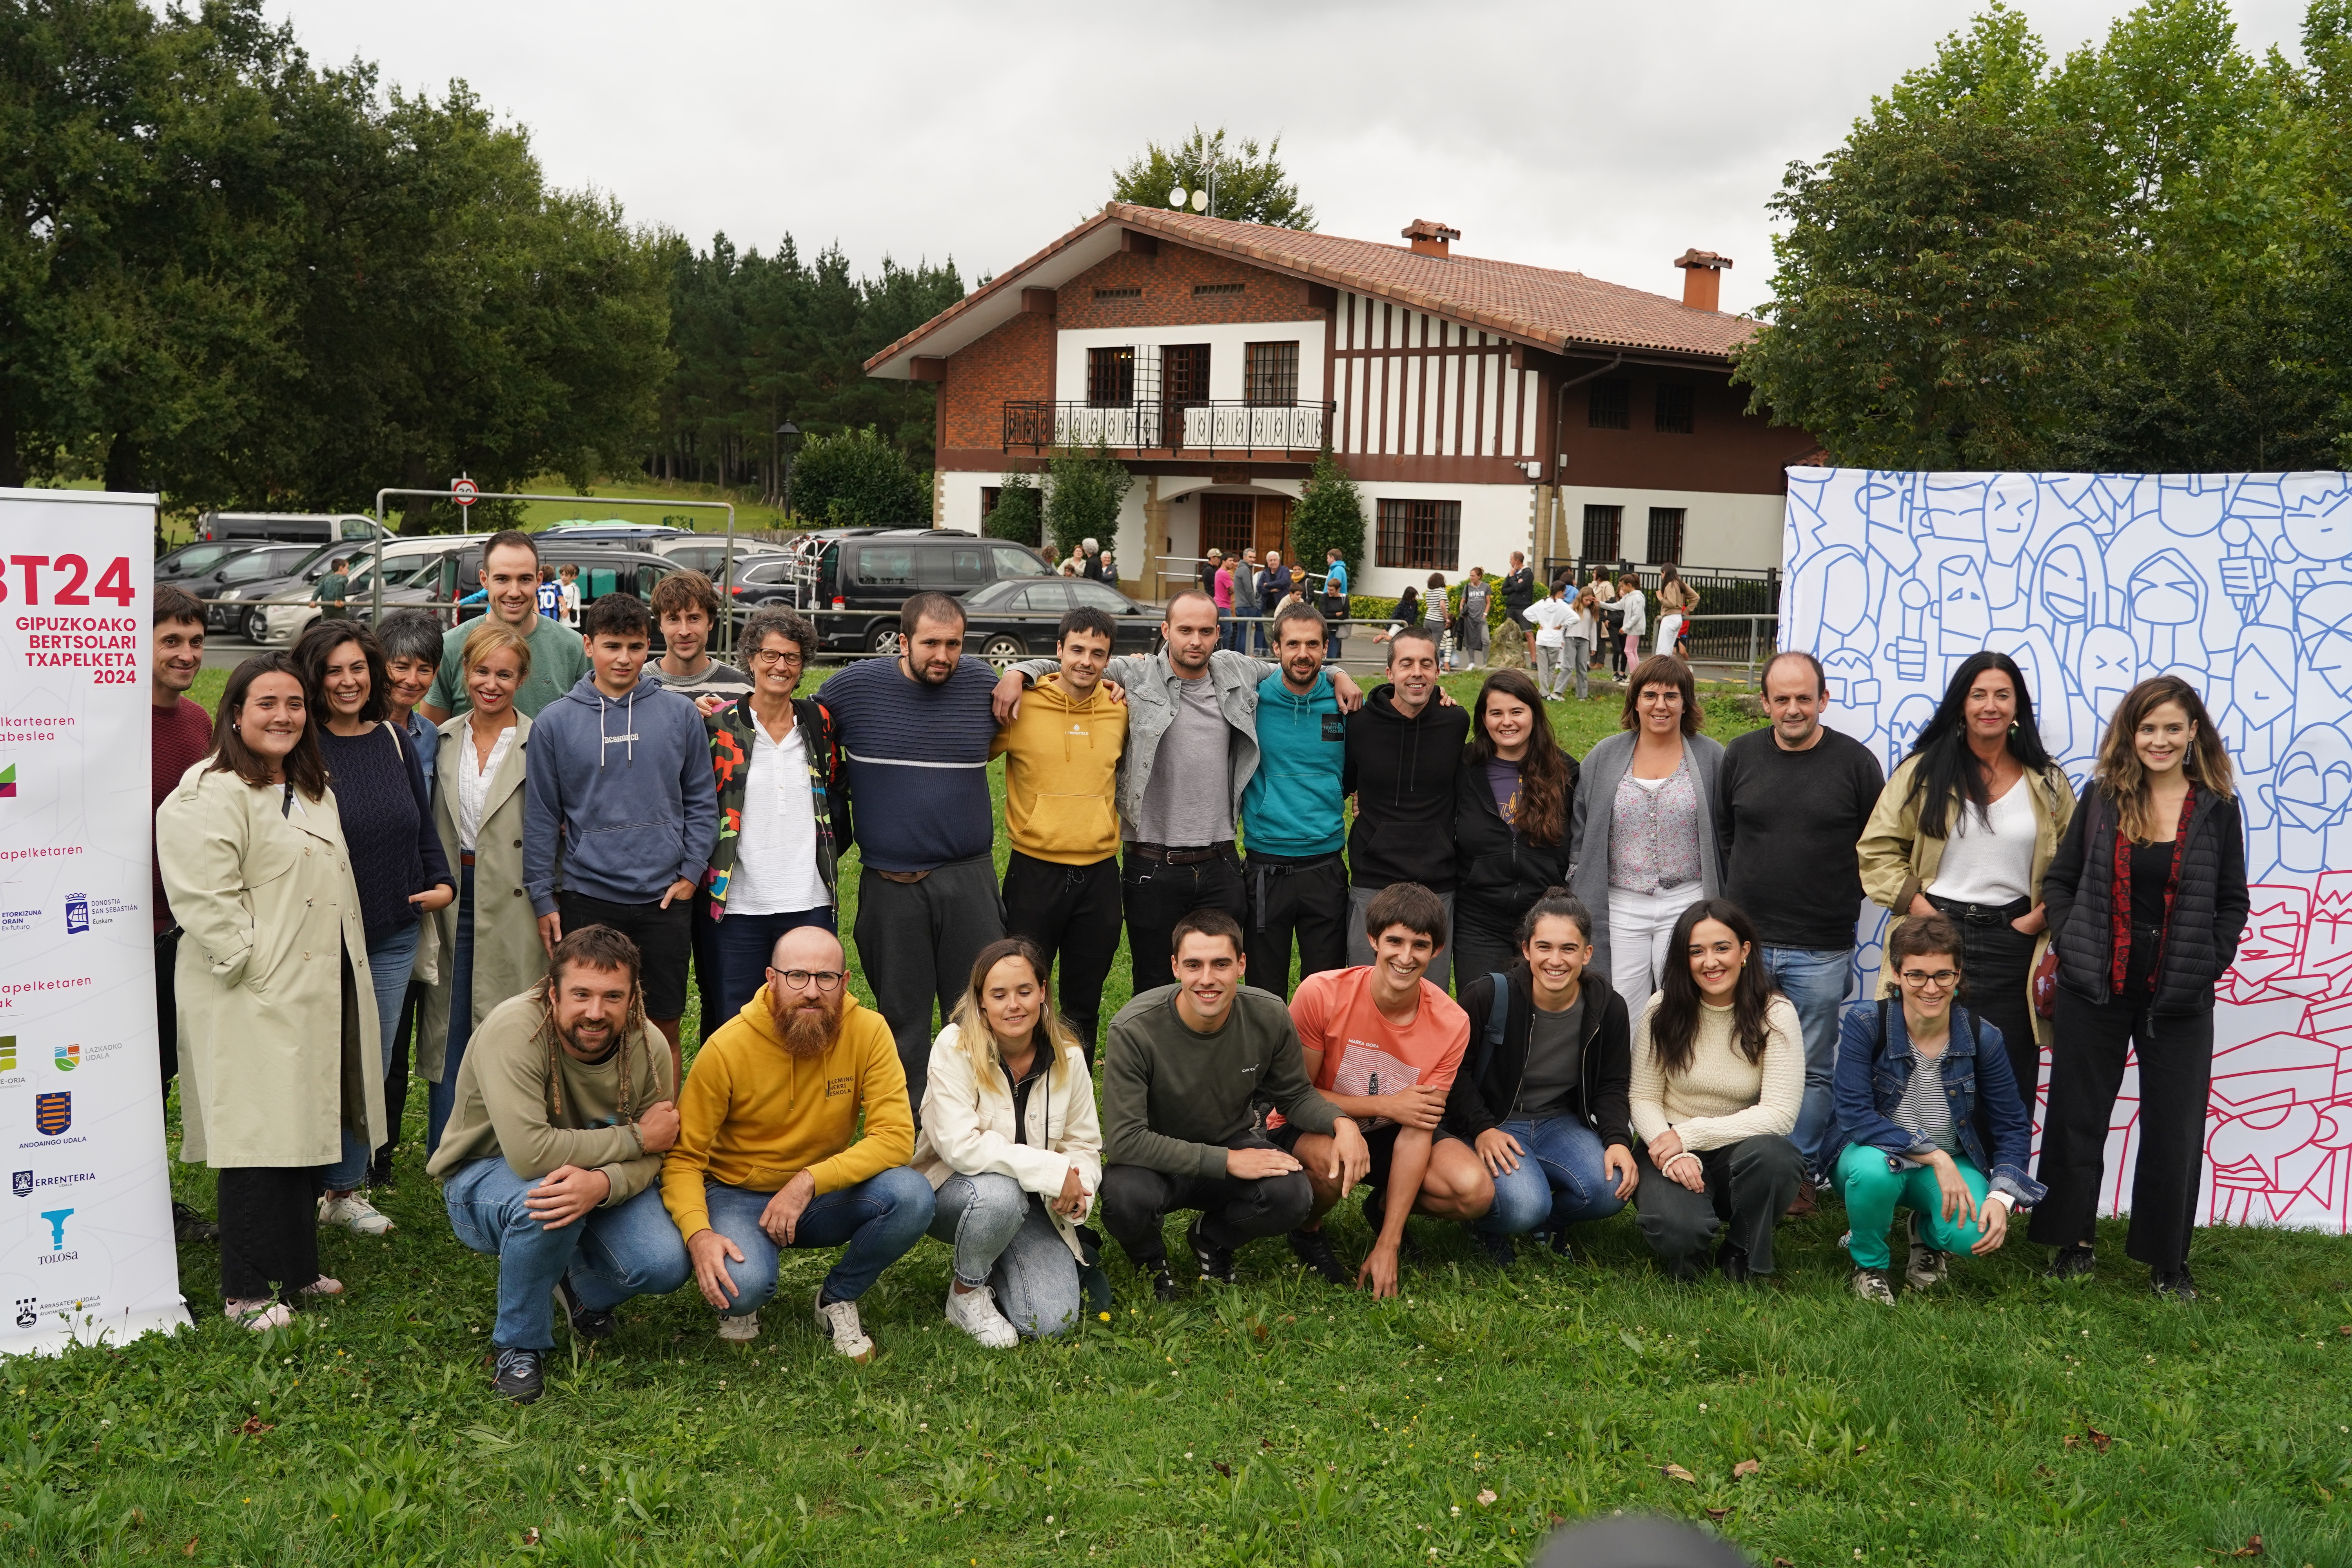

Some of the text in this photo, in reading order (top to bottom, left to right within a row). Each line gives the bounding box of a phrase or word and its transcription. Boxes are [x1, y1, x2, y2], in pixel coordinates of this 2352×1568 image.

[0, 554, 135, 607] T24
[538, 591, 555, 609] 10
[16, 617, 136, 632] GIPUZKOAKO
[30, 635, 136, 649] BERTSOLARI
[25, 653, 136, 666] TXAPELKETA
[94, 670, 136, 684] 2024
[1, 717, 74, 726] lkartearen
[0, 846, 82, 862] apelketaren
[105, 904, 138, 913] SEBASTIÁN
[2, 977, 91, 995] apelketaren
[85, 1043, 122, 1054] LAZKAOKO
[86, 1052, 110, 1061] UDALA
[830, 1076, 854, 1085] FLEMING
[19, 1139, 61, 1149] ANDOAINGO
[36, 1172, 96, 1187] ERRENTERIA
